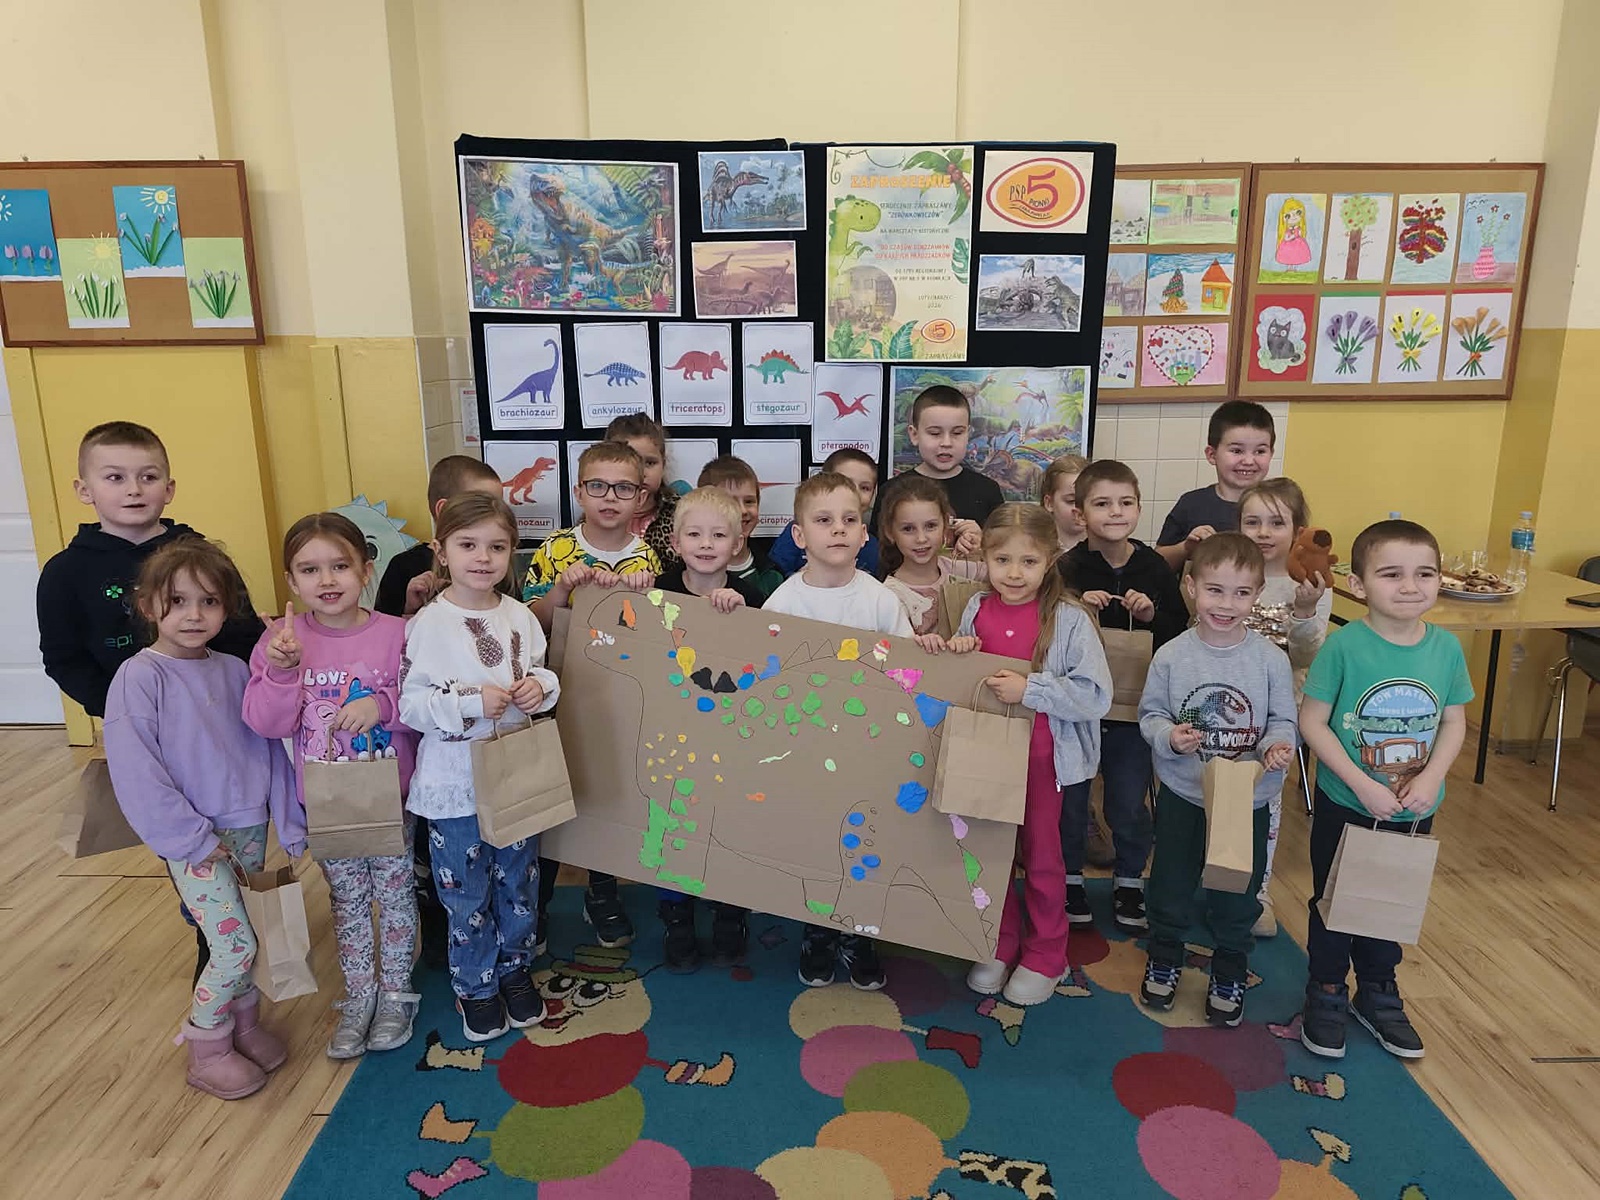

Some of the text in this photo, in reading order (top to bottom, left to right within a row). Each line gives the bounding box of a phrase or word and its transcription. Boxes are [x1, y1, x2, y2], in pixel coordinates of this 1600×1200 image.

[1009, 184, 1026, 201] PSP
[1026, 169, 1059, 212] 5
[500, 408, 556, 417] brachiozaur
[592, 405, 642, 415] ankylozaur
[670, 404, 723, 414] triceratops
[756, 403, 801, 414] stegozaur
[821, 442, 870, 451] pteranodon
[518, 519, 551, 527] nozaur
[303, 668, 349, 687] LOVE
[320, 689, 330, 698] IS
[1218, 730, 1256, 748] WORLD
